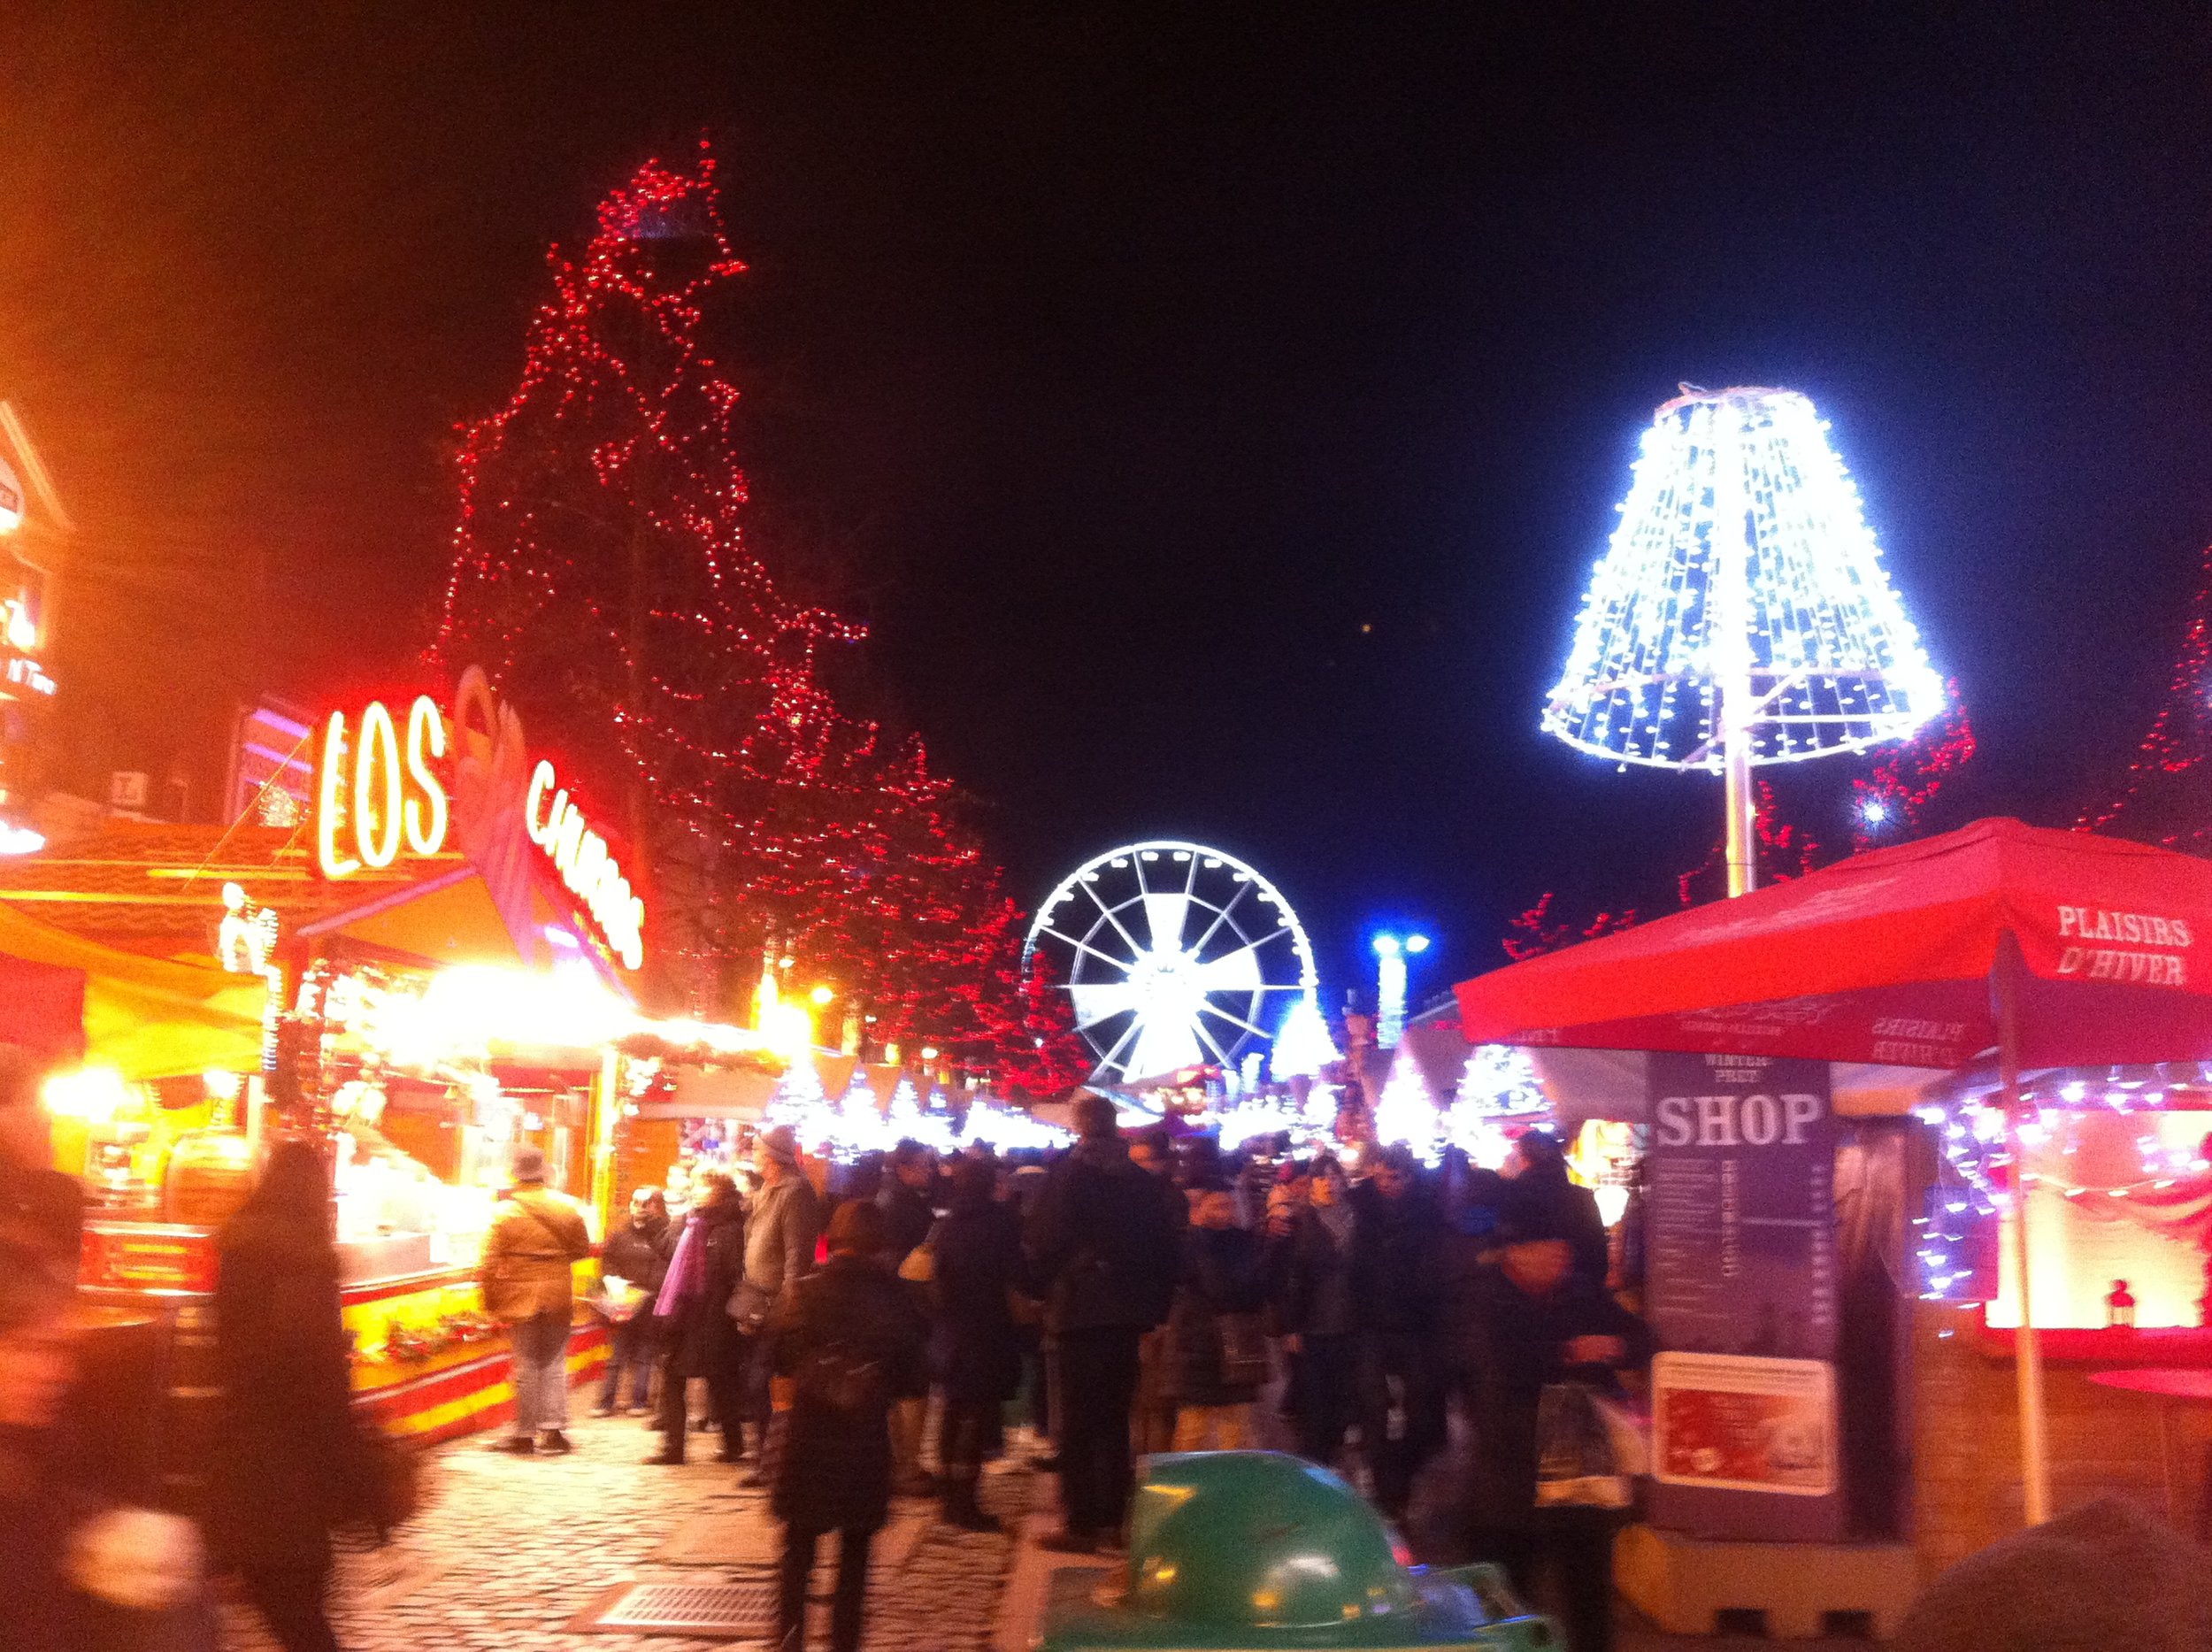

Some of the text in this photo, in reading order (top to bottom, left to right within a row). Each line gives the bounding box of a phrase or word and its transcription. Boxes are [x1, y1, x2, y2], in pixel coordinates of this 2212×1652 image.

[319, 695, 447, 880] LOS
[2057, 905, 2193, 948] PLAISIRS
[2057, 947, 2185, 986] D'HIVER
[1656, 1093, 1823, 1147] SHOP
